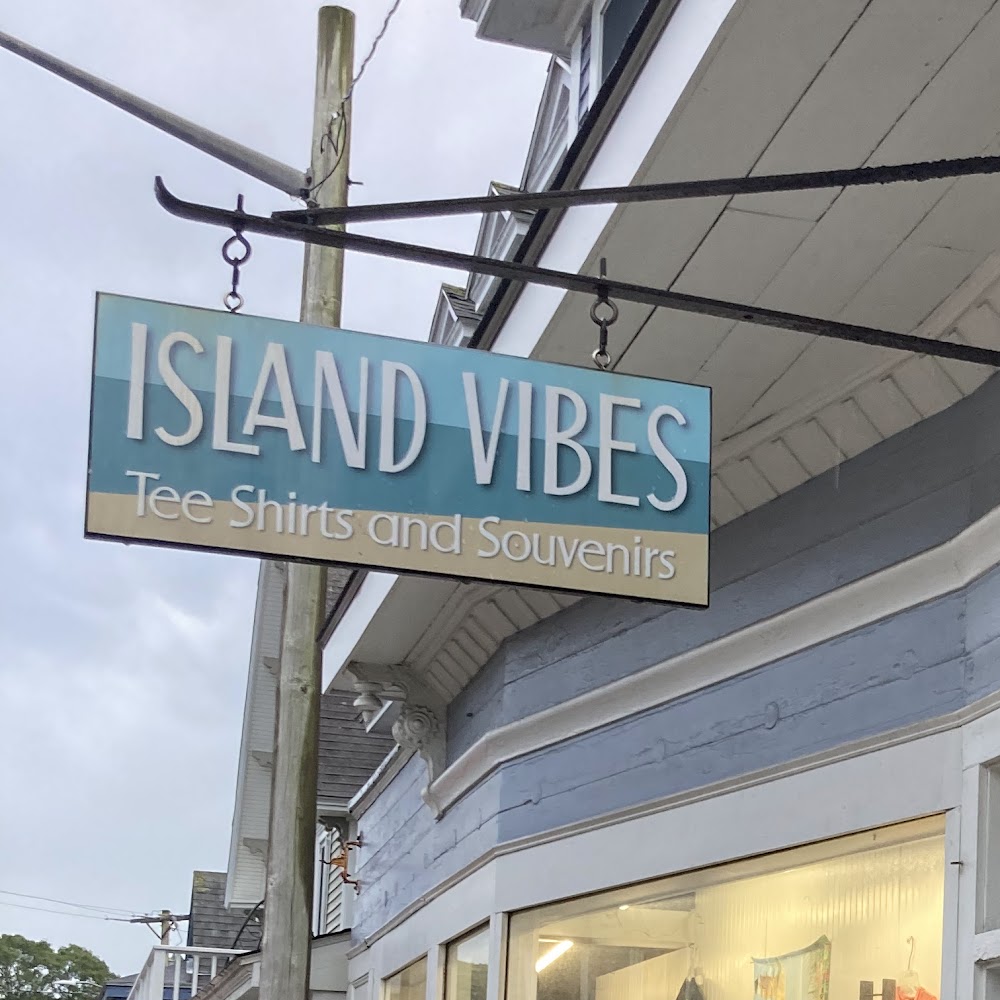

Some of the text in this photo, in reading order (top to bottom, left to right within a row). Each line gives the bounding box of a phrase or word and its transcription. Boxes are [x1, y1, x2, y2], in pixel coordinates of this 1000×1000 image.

[125, 322, 689, 512] ISLAND VIBES
[125, 470, 677, 581] Tee Shirts and Souvenirs
